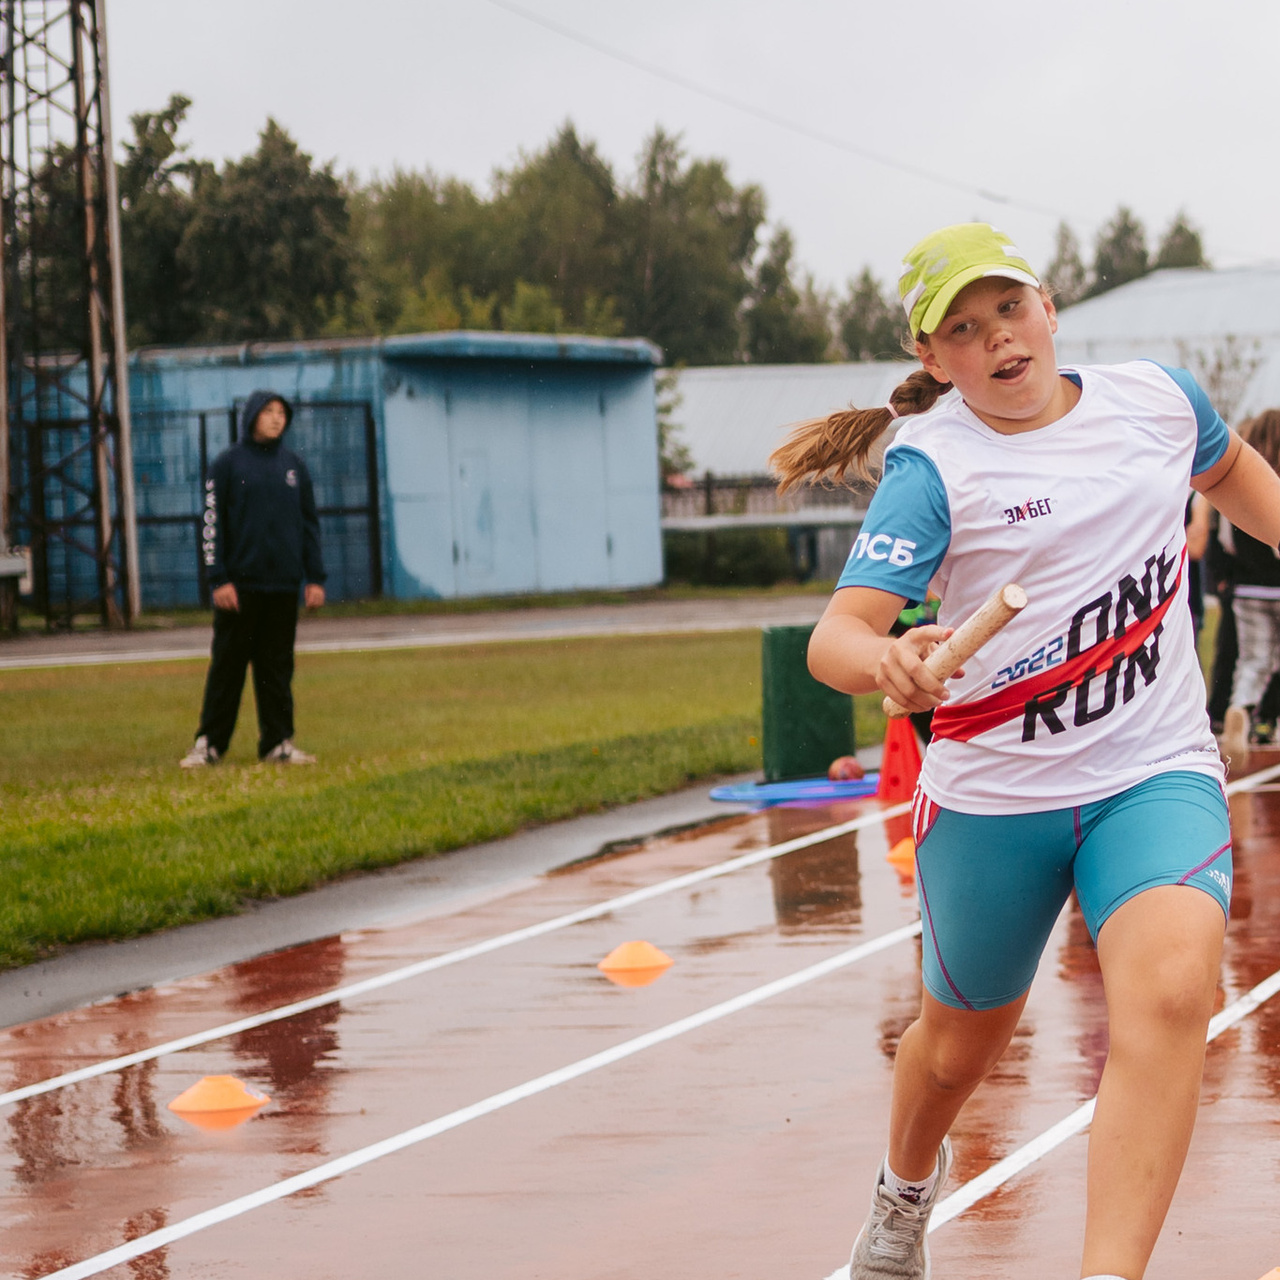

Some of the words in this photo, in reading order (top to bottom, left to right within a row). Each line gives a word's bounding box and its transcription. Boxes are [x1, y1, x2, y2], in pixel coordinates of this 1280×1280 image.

[202, 478, 217, 566] SWOOSH
[1004, 497, 1052, 525] ЗАБЕГ
[849, 532, 917, 567] ПСБ
[1066, 538, 1177, 662] ONE
[991, 636, 1063, 690] 2022
[1021, 621, 1164, 743] RUN
